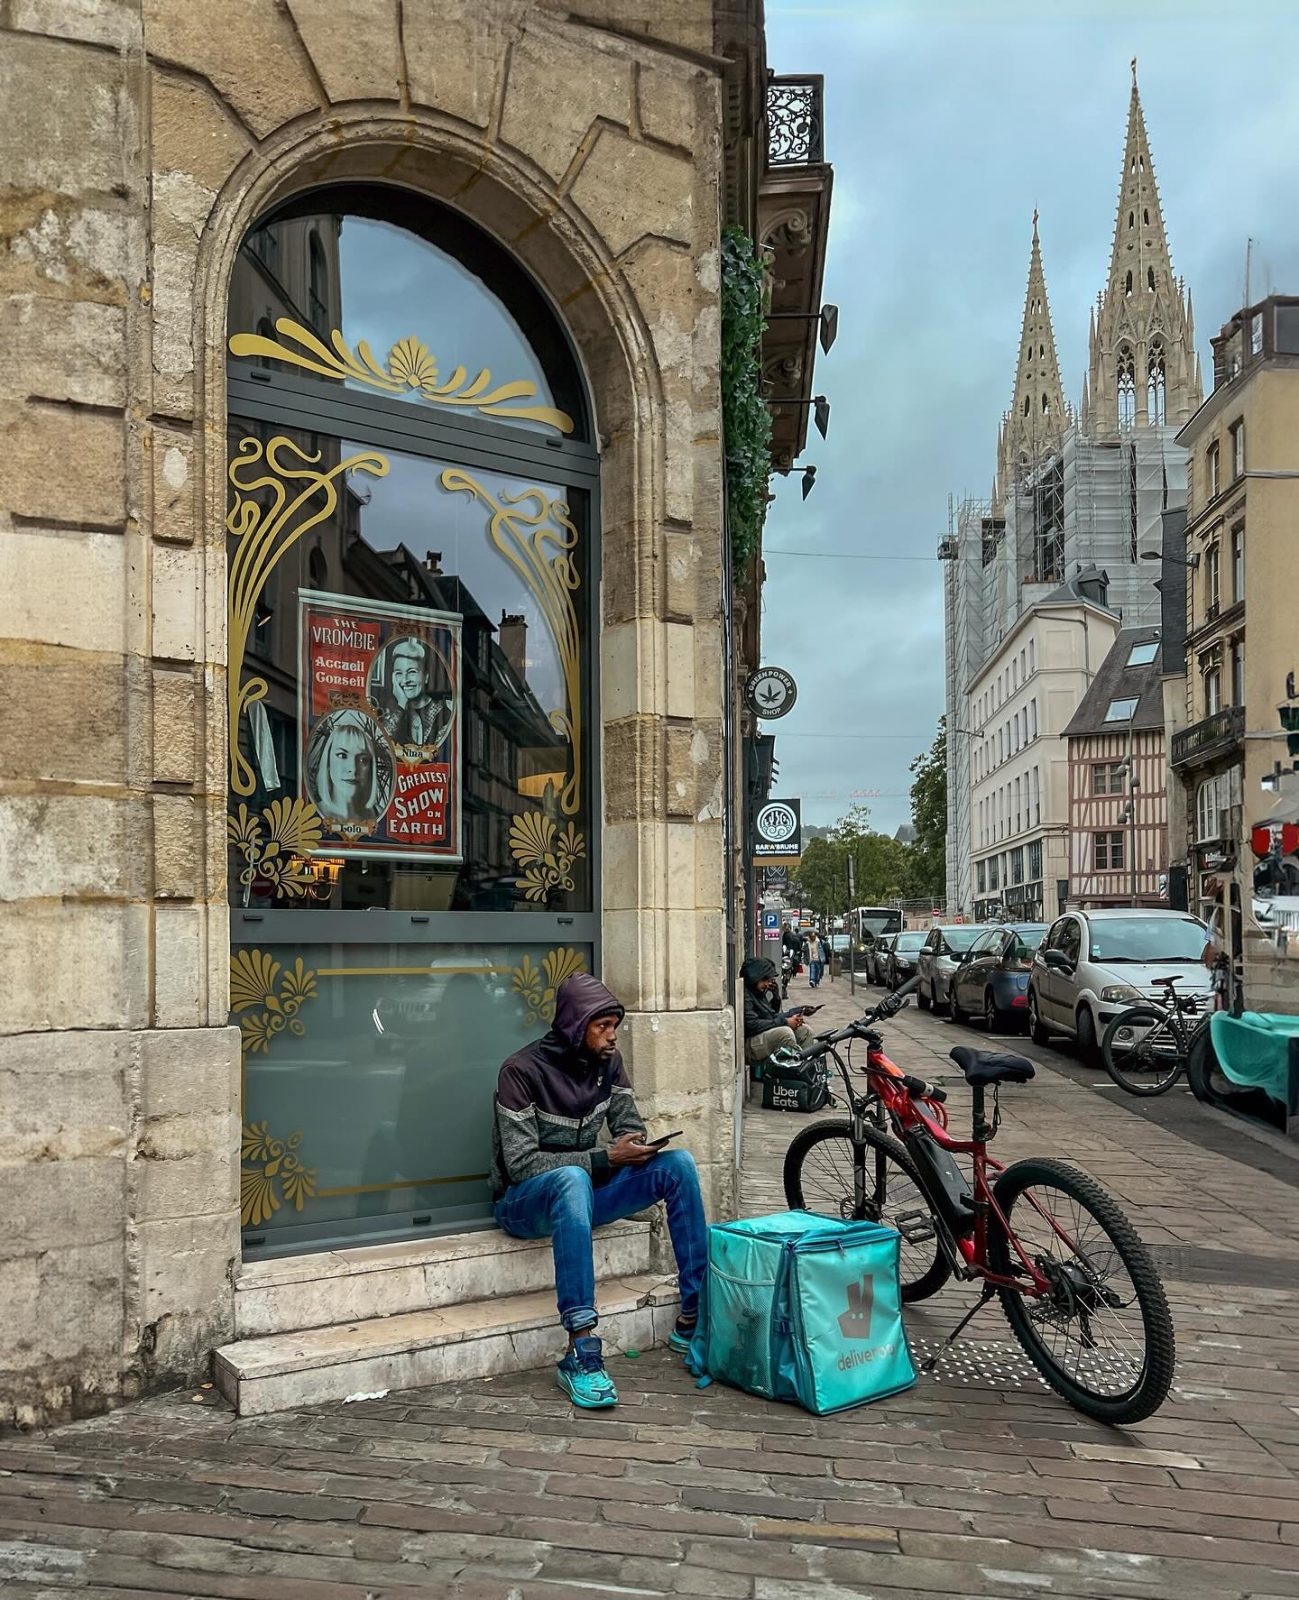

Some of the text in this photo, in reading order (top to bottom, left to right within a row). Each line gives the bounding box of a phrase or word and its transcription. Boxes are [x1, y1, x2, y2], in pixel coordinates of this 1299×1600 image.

[333, 618, 359, 630] THE
[312, 625, 376, 651] VROMBIE
[315, 671, 366, 688] Conseil
[748, 670, 792, 691] GREEN POWER
[761, 707, 782, 716] SHOP
[402, 748, 424, 759] Nina
[398, 771, 447, 794] GREATEST
[394, 788, 445, 819] SHOW
[426, 810, 441, 818] ON
[389, 819, 443, 836] EARTH
[766, 915, 775, 926] P
[772, 1084, 799, 1097] Uber
[772, 1096, 799, 1108] Eats
